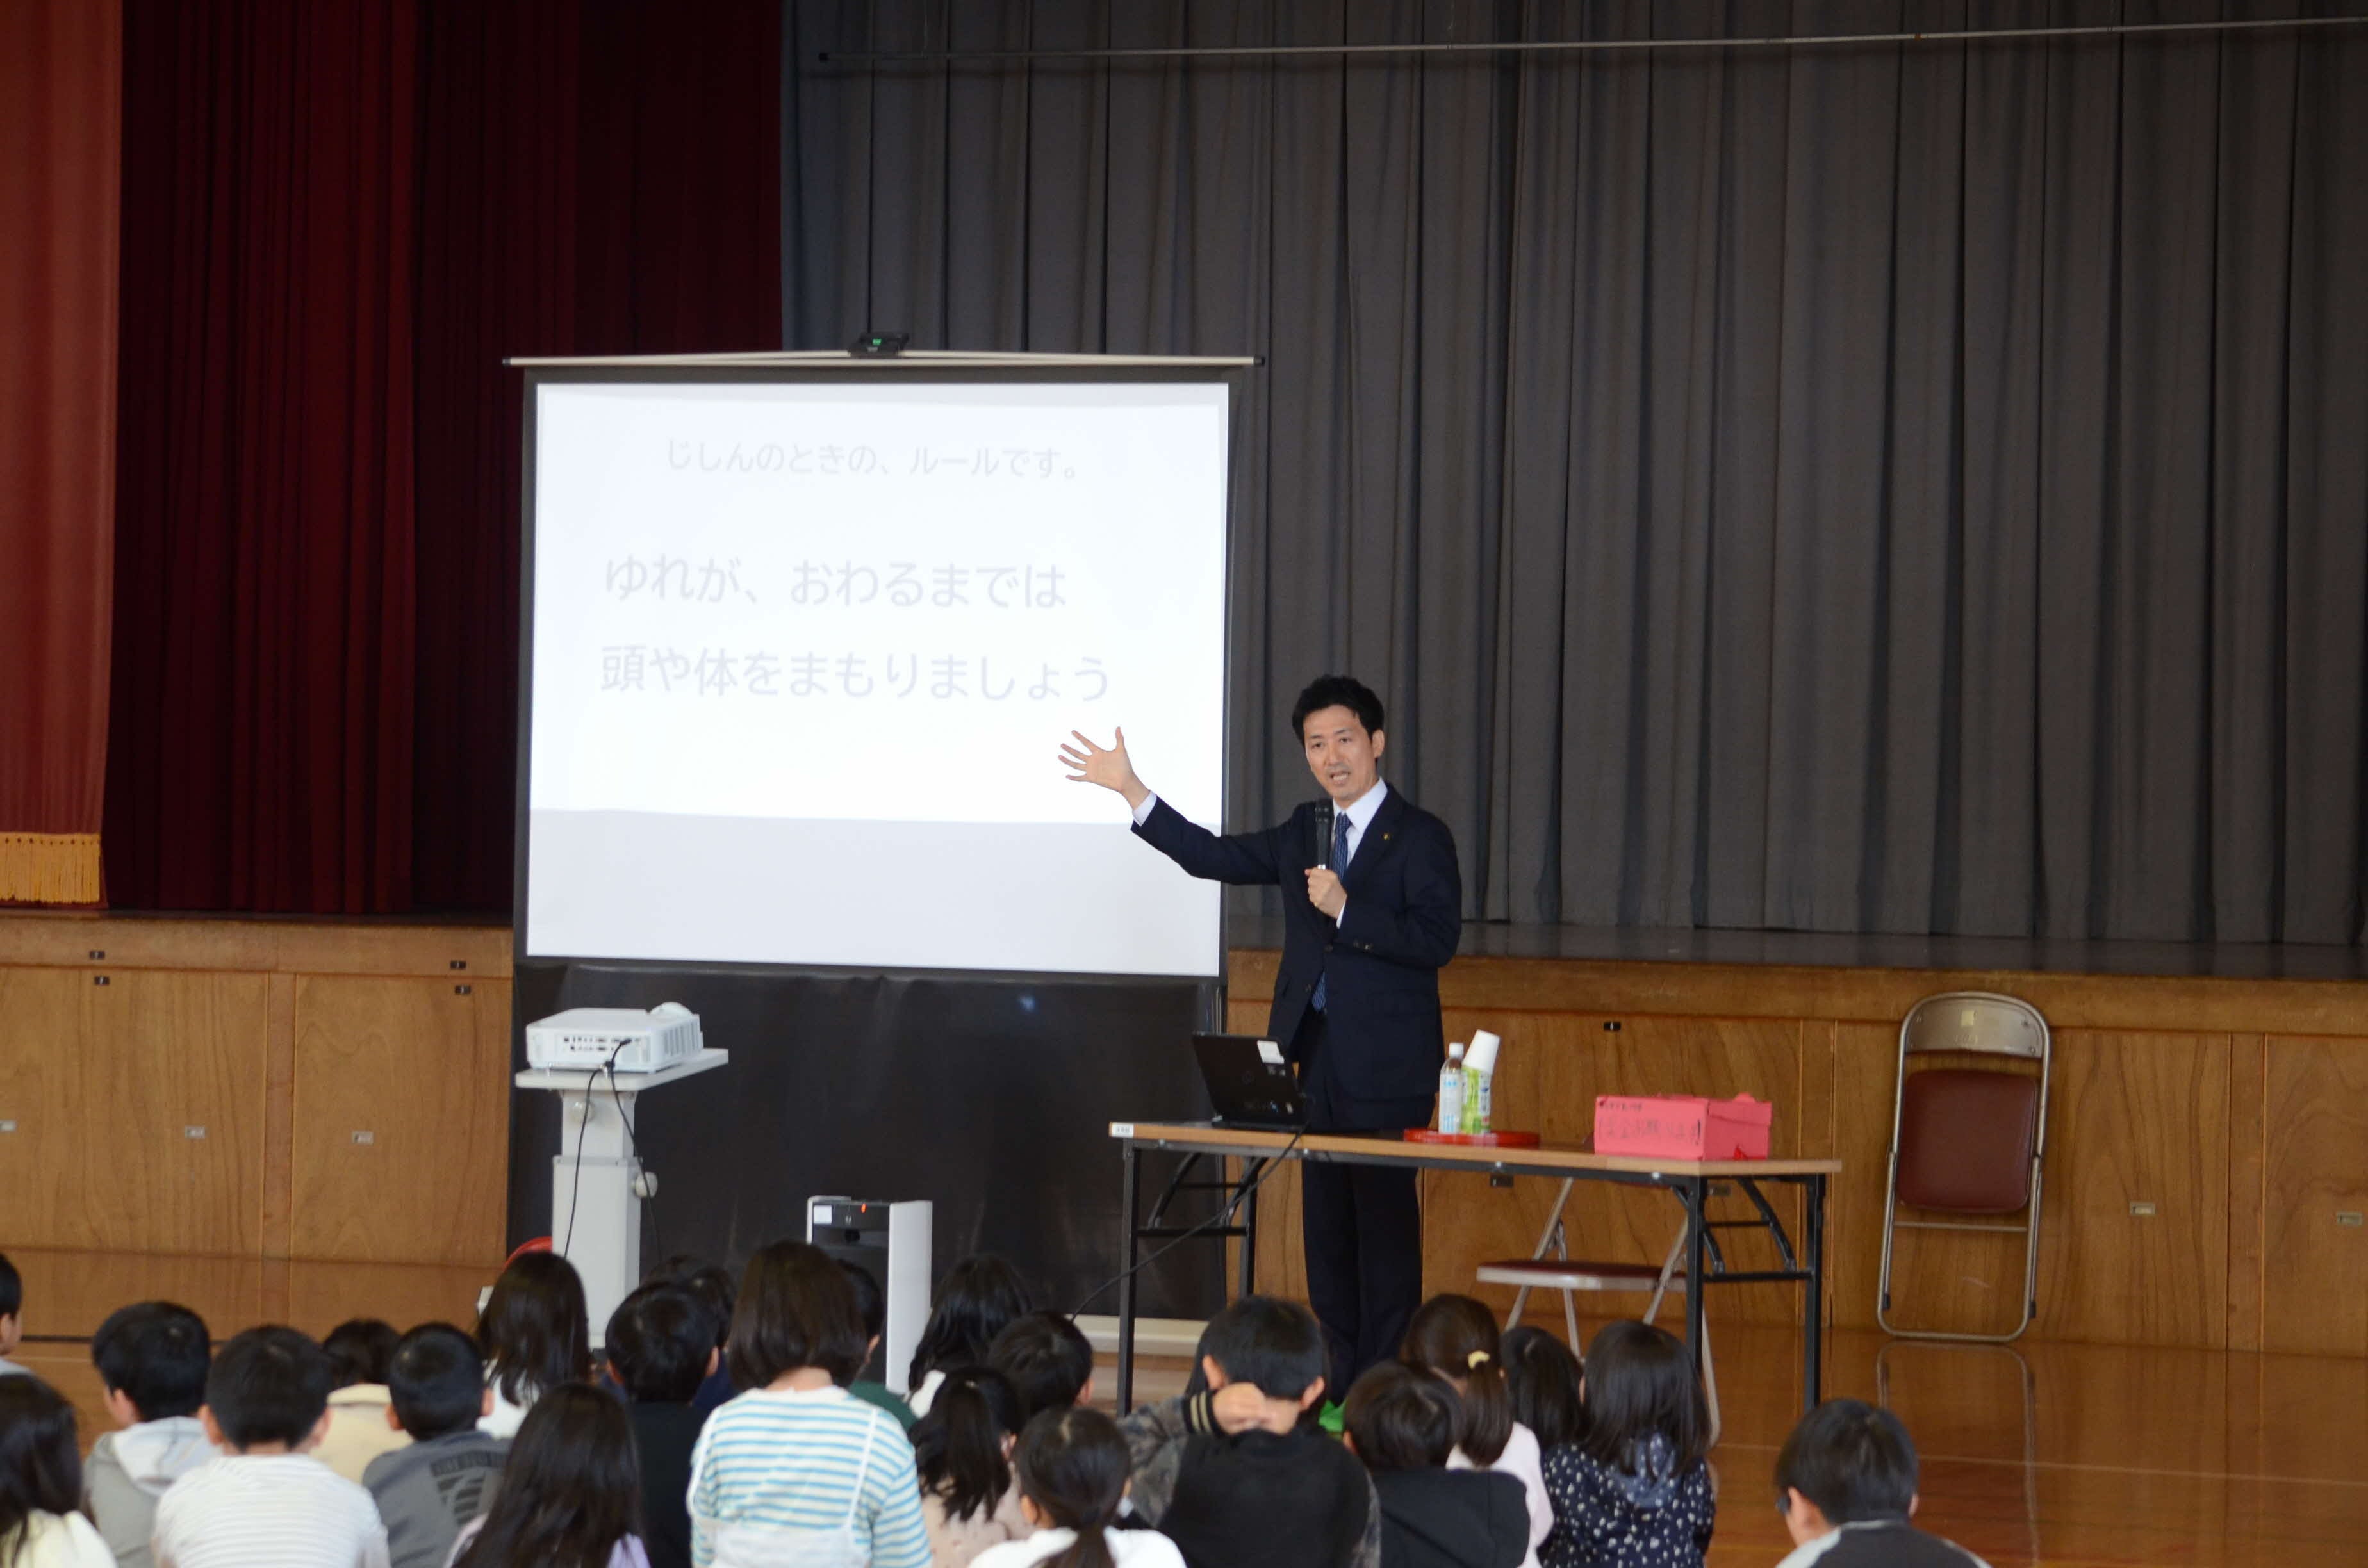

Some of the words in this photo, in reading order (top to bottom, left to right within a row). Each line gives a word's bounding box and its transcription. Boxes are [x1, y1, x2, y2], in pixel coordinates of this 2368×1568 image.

[668, 436, 1077, 481] じしんのときの、ルールです。
[605, 555, 1066, 609] ゆれが、おわるまでは
[600, 645, 1110, 701] 頭や体をまもりましょう
